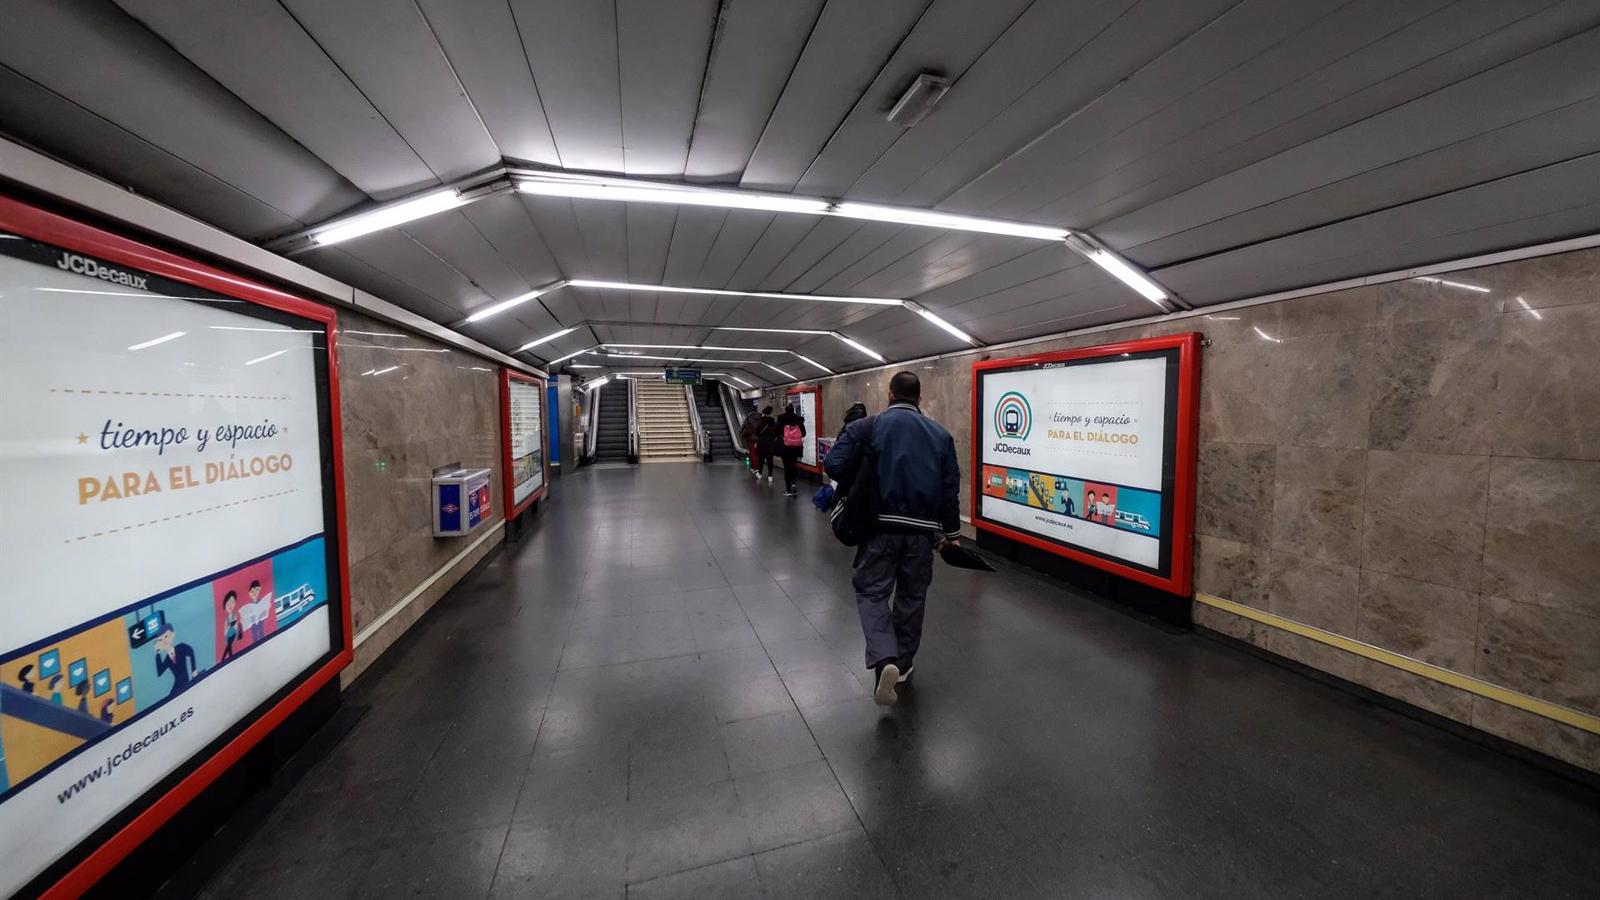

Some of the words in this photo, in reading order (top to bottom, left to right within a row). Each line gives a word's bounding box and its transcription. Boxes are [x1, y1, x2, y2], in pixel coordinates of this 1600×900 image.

[56, 252, 148, 290] JCDecaux
[1053, 411, 1082, 427] tiempo
[1085, 417, 1091, 427] y
[1094, 412, 1130, 427] espacio
[100, 419, 188, 456] tiempo
[197, 428, 210, 452] y
[215, 419, 278, 449] espacio
[993, 442, 1031, 456] JCDecaux
[1048, 429, 1071, 440] PARA
[1074, 430, 1084, 441] EL
[1087, 429, 1138, 445] DIÁLOGO
[78, 470, 162, 505] PARA
[169, 465, 199, 490] EL
[205, 453, 293, 486] DIÁLOGO
[1035, 515, 1073, 530] www.jcdecaux.es
[57, 706, 194, 804] www.jcdecaux.es
